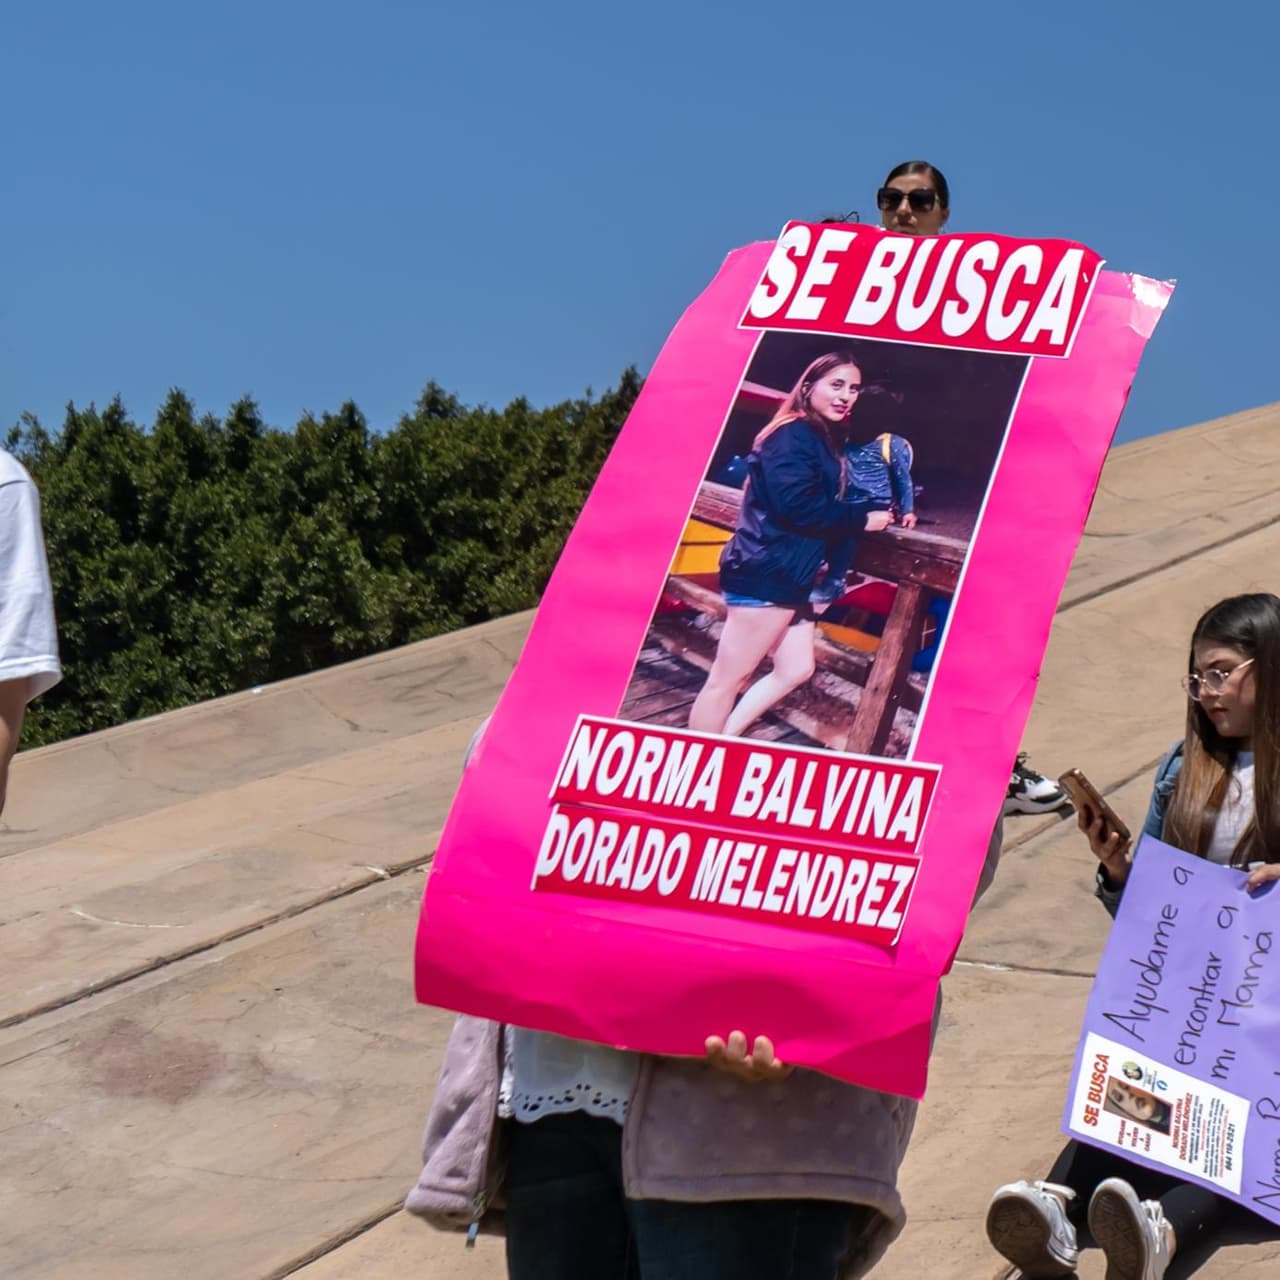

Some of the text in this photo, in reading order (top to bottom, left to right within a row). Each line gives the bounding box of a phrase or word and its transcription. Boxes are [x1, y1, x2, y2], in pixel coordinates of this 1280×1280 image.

[749, 223, 1085, 345] SE BUSCA
[559, 725, 925, 843] NORMA BALVINA
[535, 814, 913, 931] DORADO MELENDREZ
[1102, 865, 1195, 1043] Ayudame a
[1174, 951, 1224, 1067] encontrar
[1218, 905, 1240, 929] a
[1083, 1053, 1110, 1126] SE BUSCA
[1210, 1048, 1236, 1081] mi
